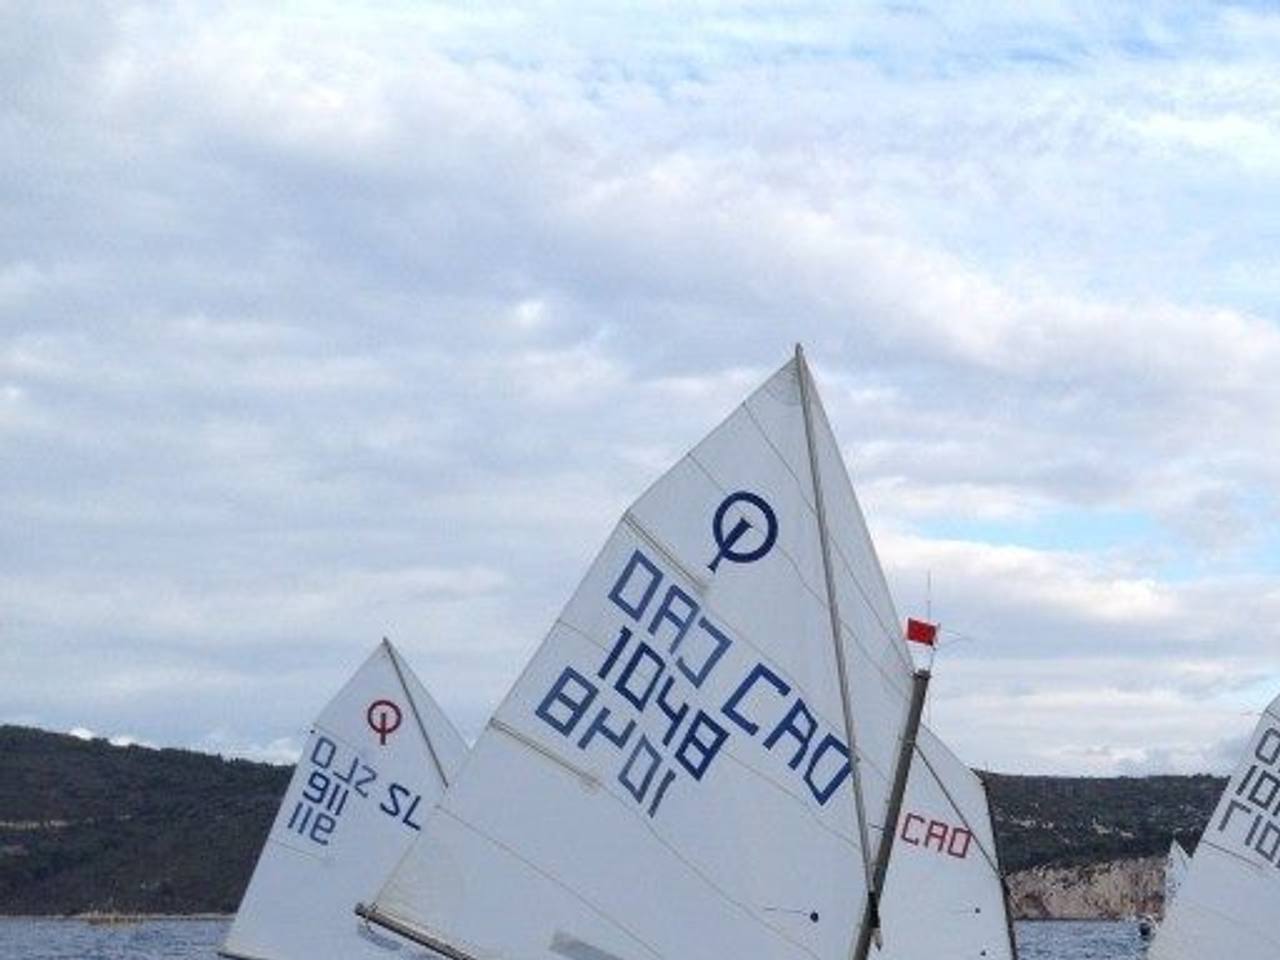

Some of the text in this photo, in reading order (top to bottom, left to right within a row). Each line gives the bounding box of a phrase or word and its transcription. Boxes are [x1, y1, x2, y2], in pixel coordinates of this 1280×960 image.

[598, 625, 731, 781] 1048
[302, 771, 349, 816] 911
[379, 782, 422, 831] SL
